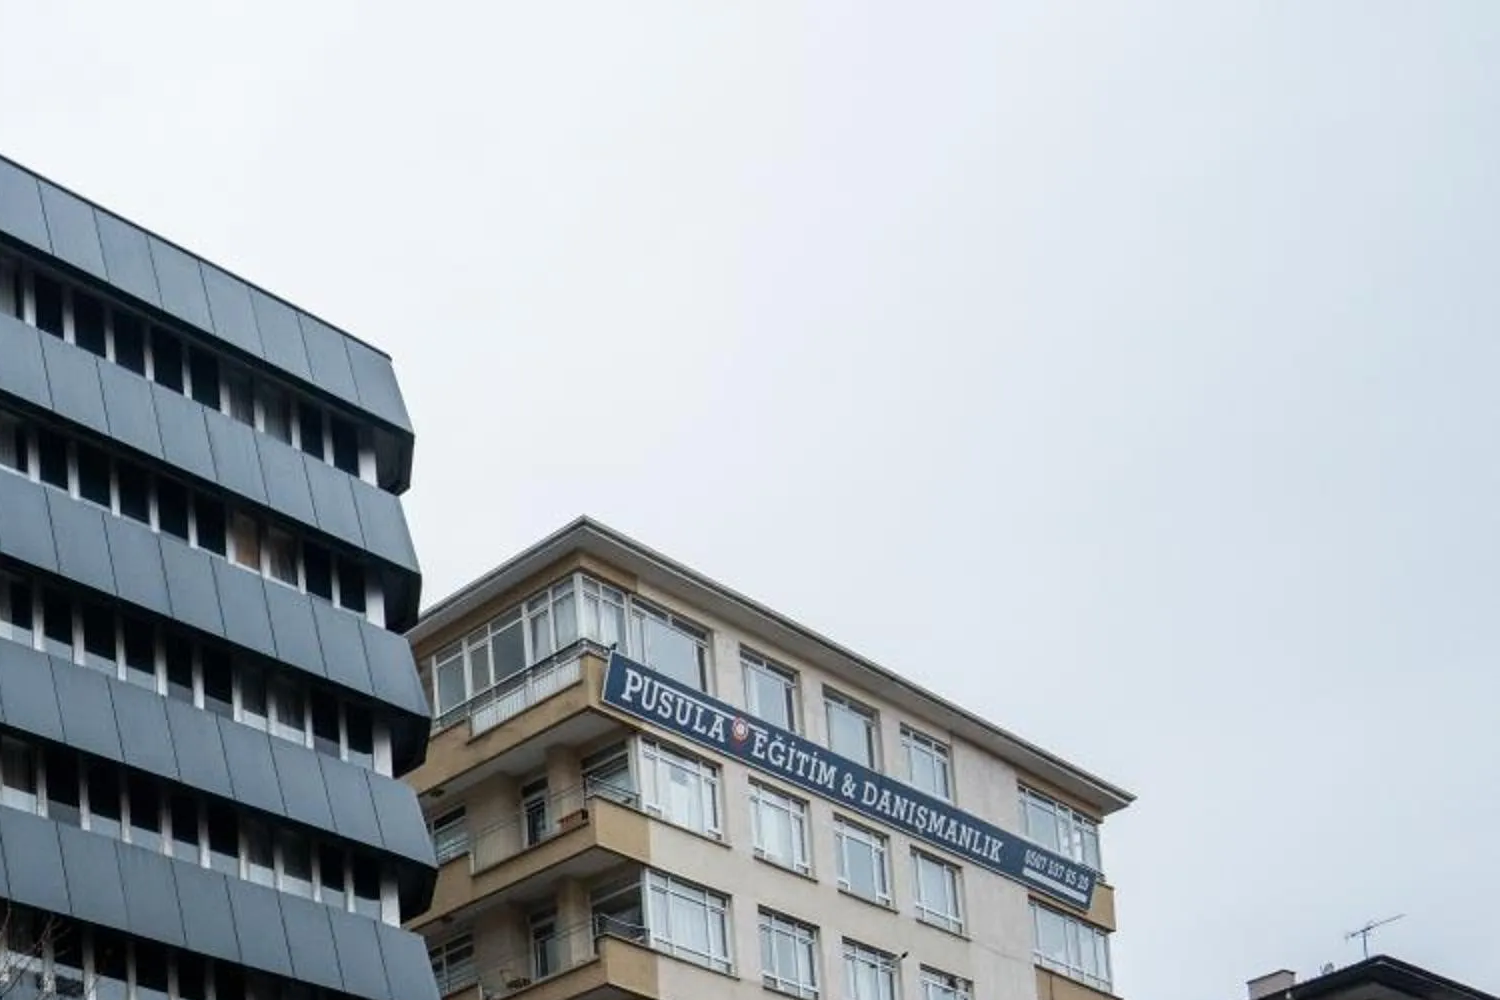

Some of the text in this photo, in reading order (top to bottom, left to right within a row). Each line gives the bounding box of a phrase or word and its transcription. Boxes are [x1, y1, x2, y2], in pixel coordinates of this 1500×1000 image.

[621, 668, 1004, 865] PUSULA EĞİTİM & DANIŞMANLIK
